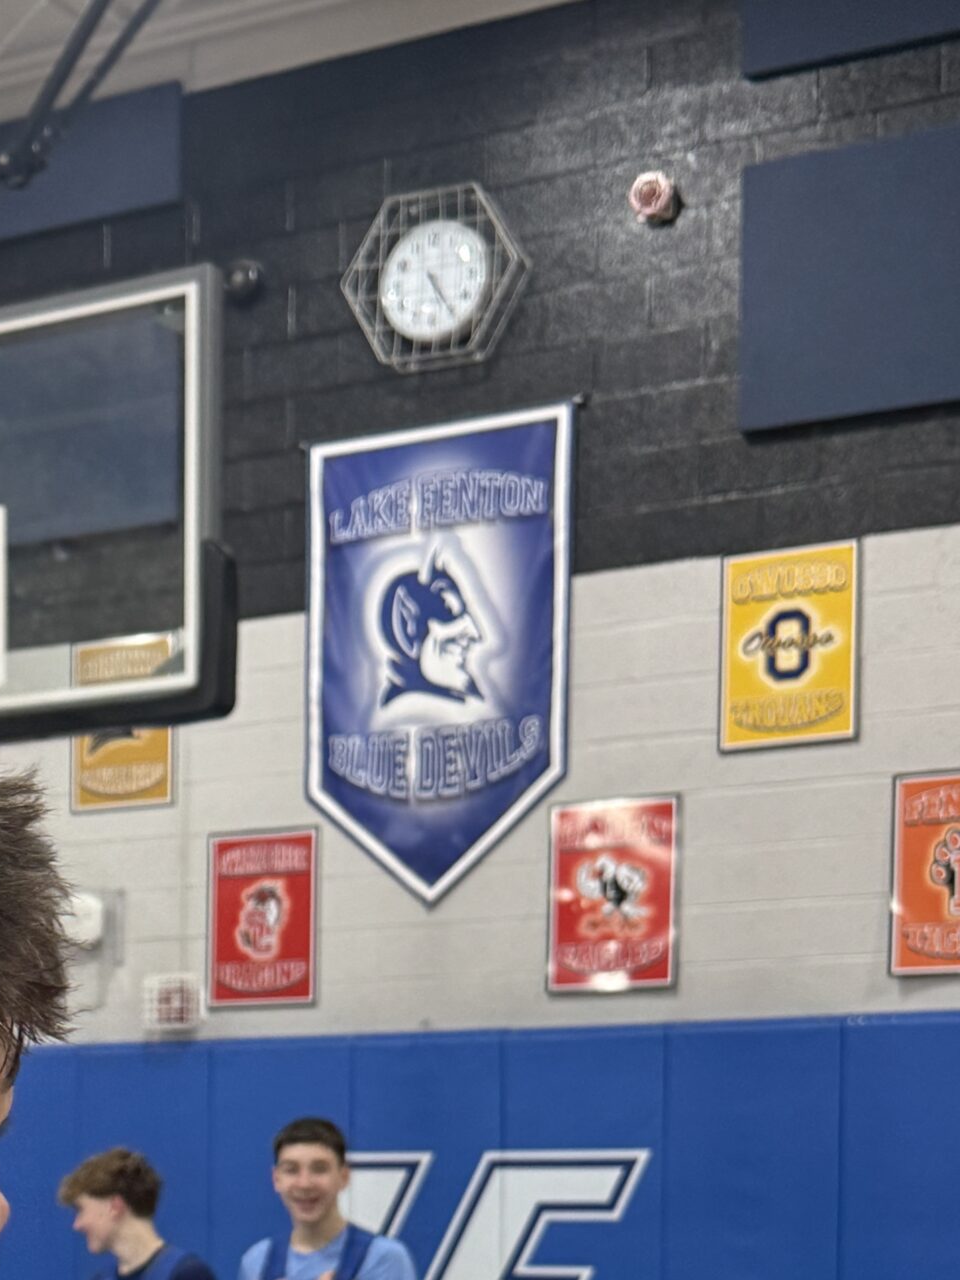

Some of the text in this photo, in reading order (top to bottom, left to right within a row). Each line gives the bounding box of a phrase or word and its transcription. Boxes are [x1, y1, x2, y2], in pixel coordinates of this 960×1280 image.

[329, 469, 549, 544] LAKE FENTON
[328, 714, 543, 799] BLUE DEVILS
